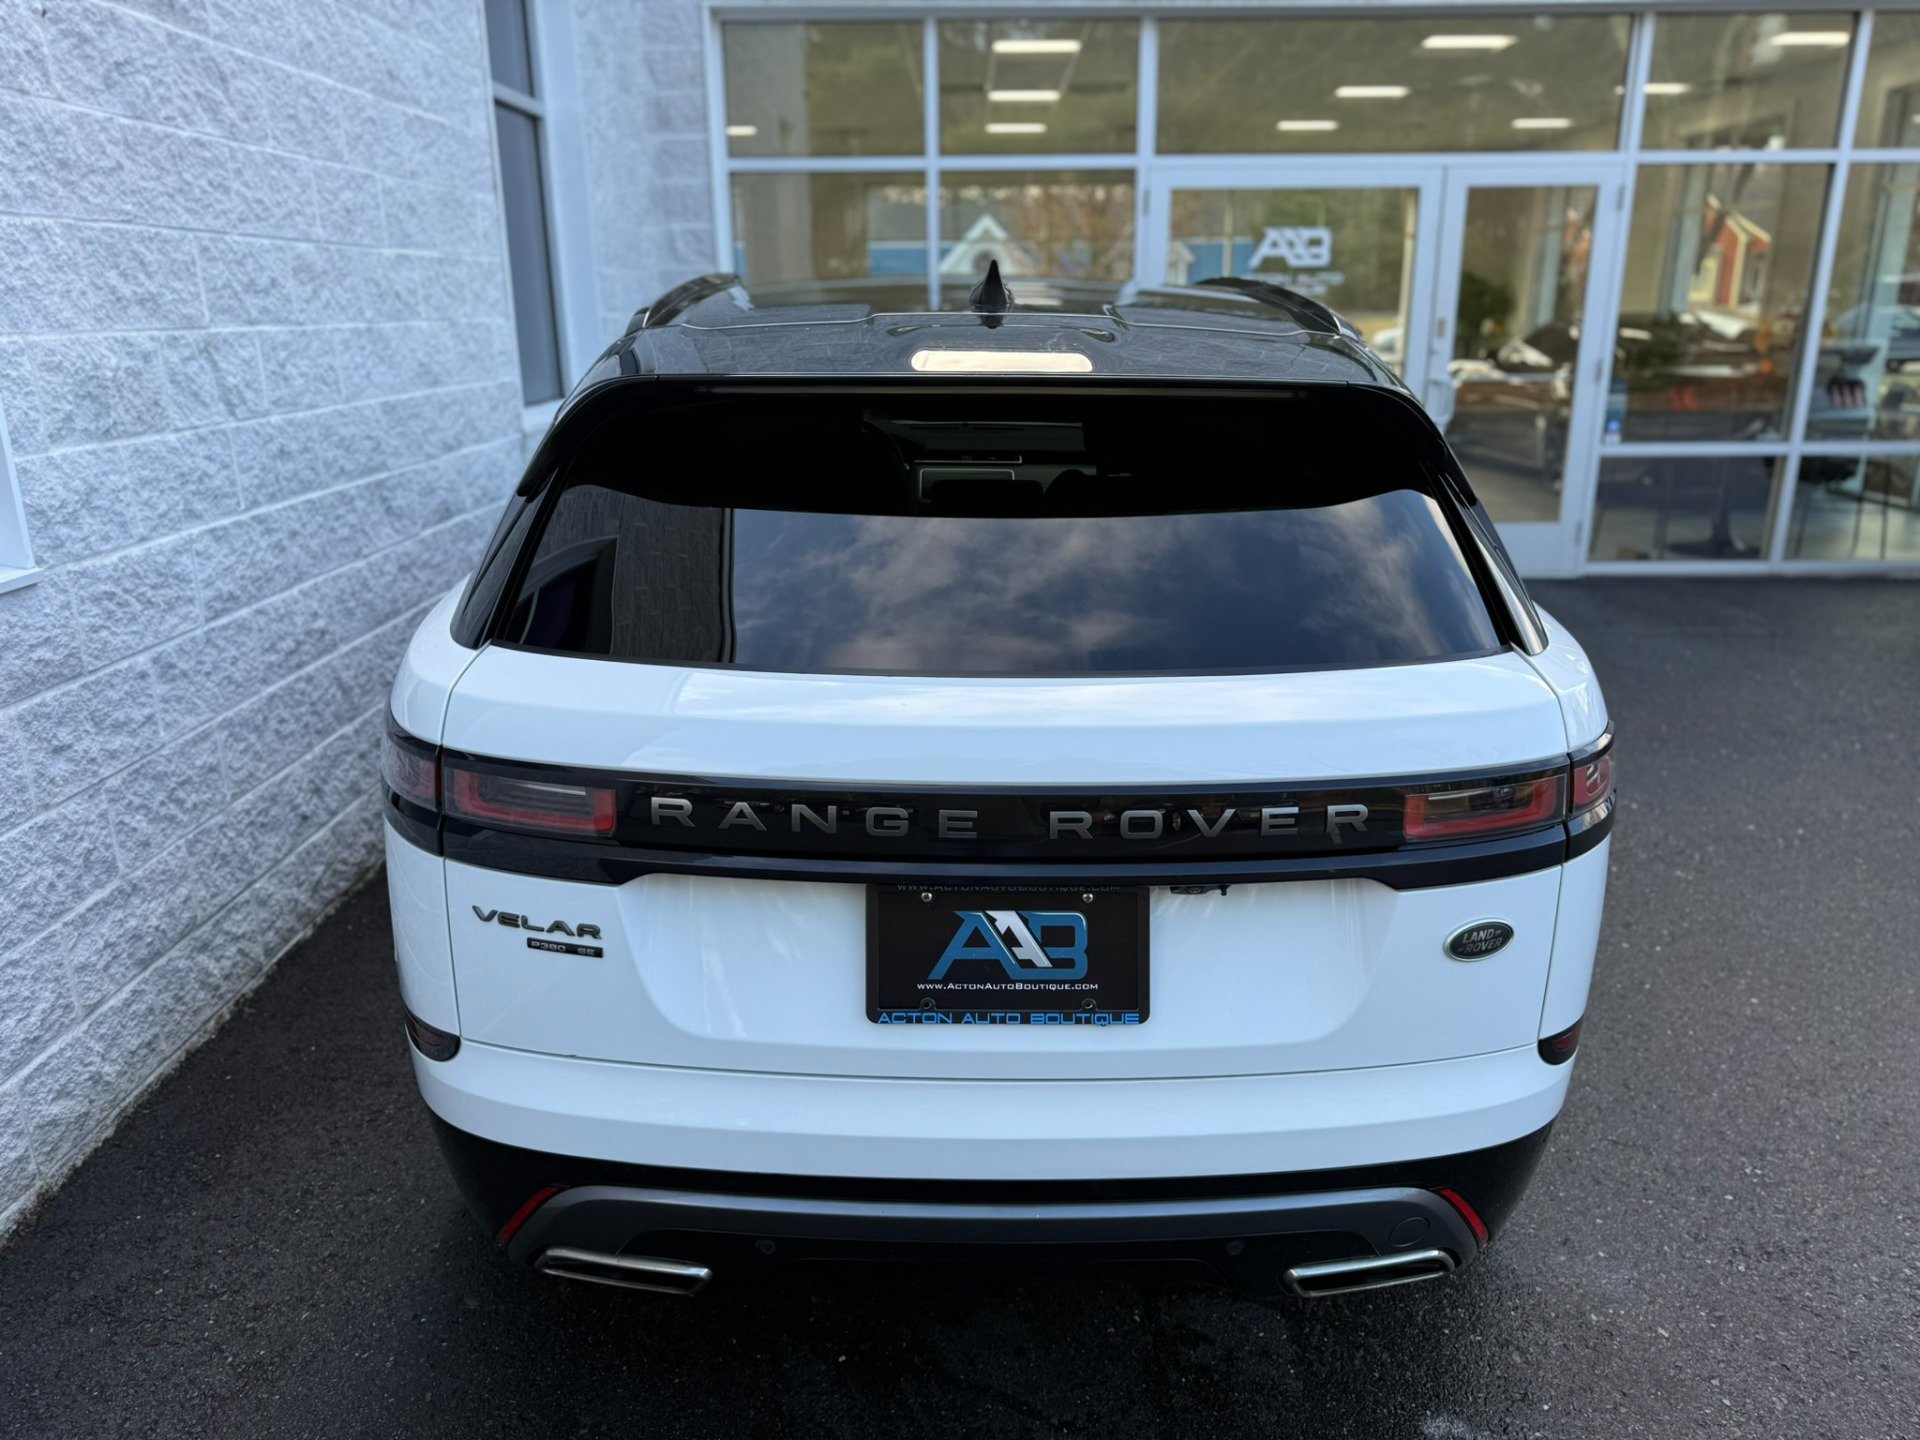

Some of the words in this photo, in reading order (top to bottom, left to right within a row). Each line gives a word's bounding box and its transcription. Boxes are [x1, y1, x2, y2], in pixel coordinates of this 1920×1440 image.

[650, 796, 978, 839] RANGE
[1049, 803, 1369, 840] ROVER
[472, 904, 602, 940] VELAR
[1462, 928, 1495, 944] LAND
[1464, 937, 1503, 954] ROVER
[878, 1012, 953, 1025] ACTON
[961, 1012, 1021, 1025] AUTO
[1030, 1012, 1140, 1027] BOUTIQUE
